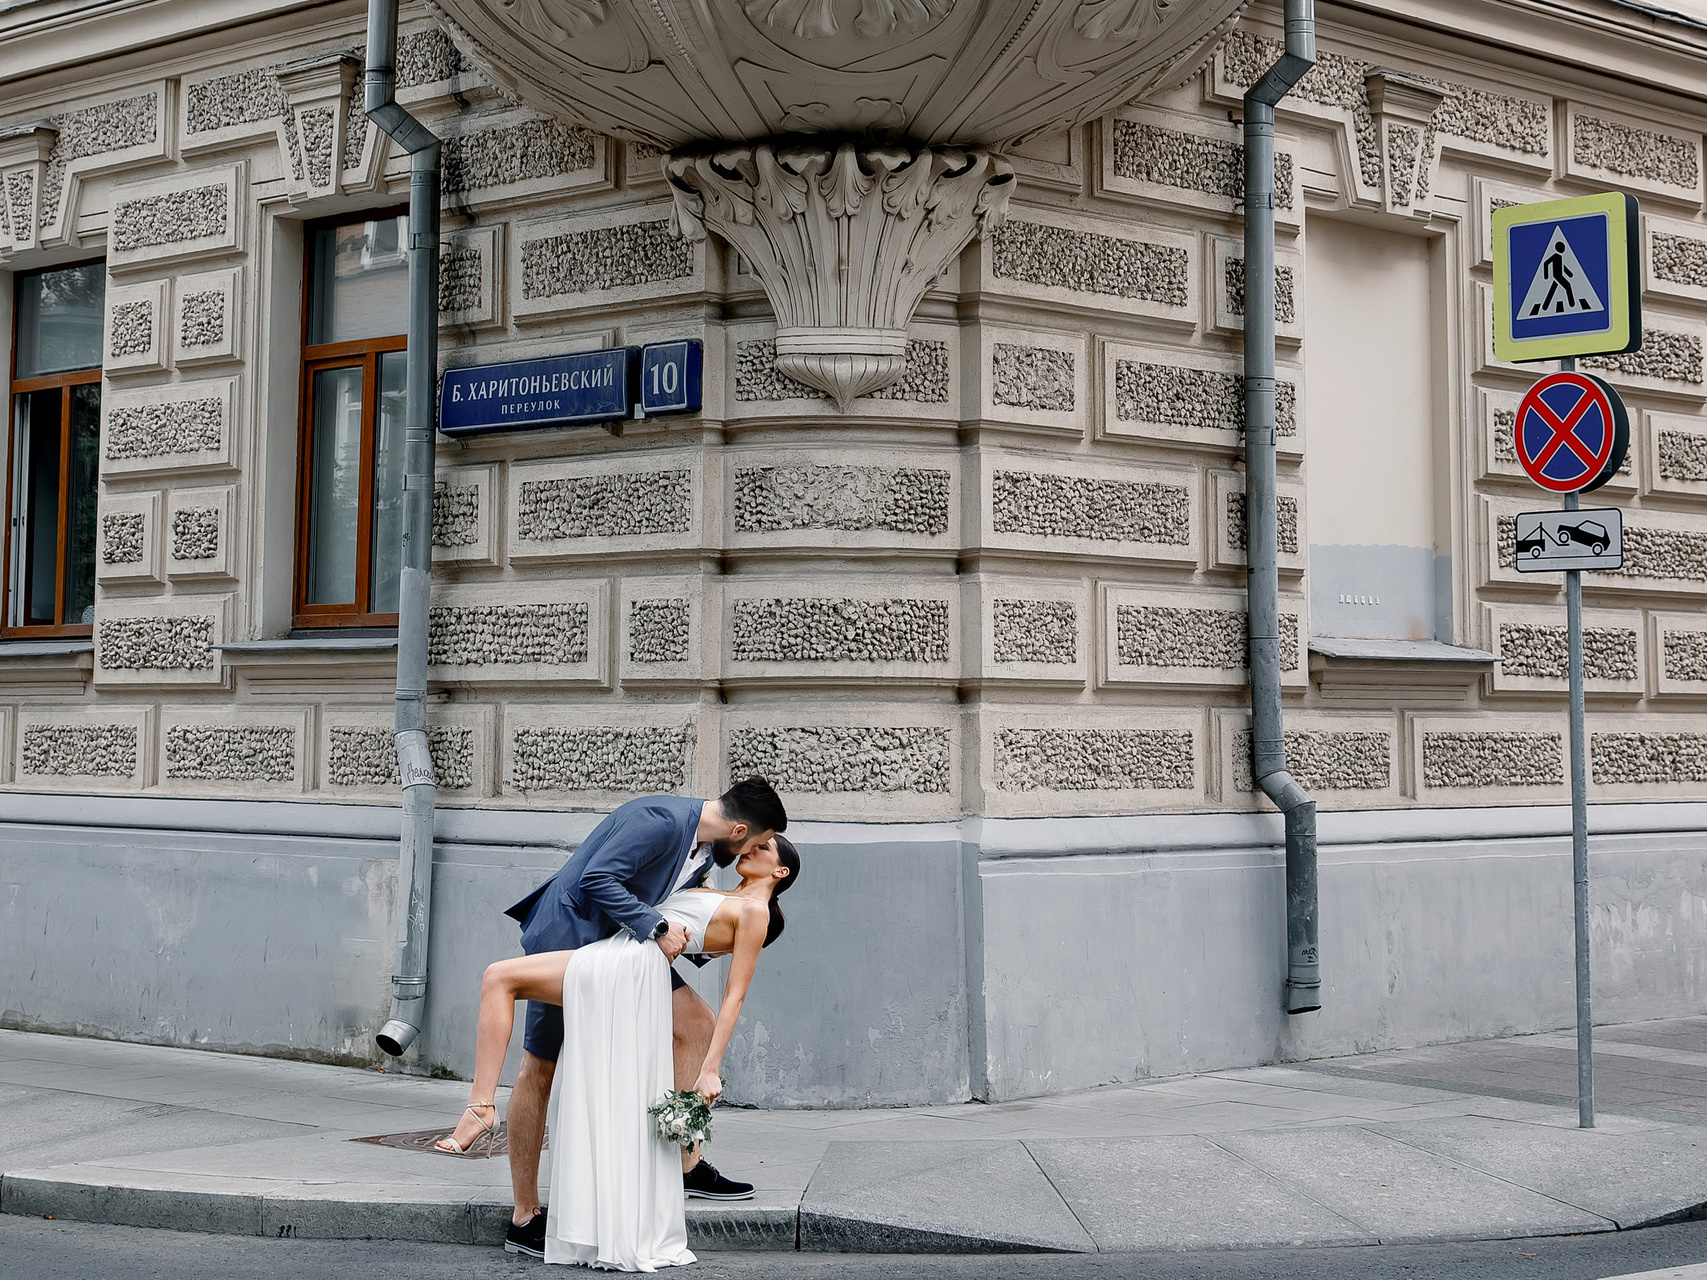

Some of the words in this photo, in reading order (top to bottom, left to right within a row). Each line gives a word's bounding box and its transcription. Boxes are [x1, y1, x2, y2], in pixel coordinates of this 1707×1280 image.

[452, 384, 464, 402] Б.
[468, 363, 614, 402] ХАРИТОНЬЕВСКИЙ
[650, 361, 678, 395] 10
[501, 399, 561, 415] ПЕРЕУЛОК
